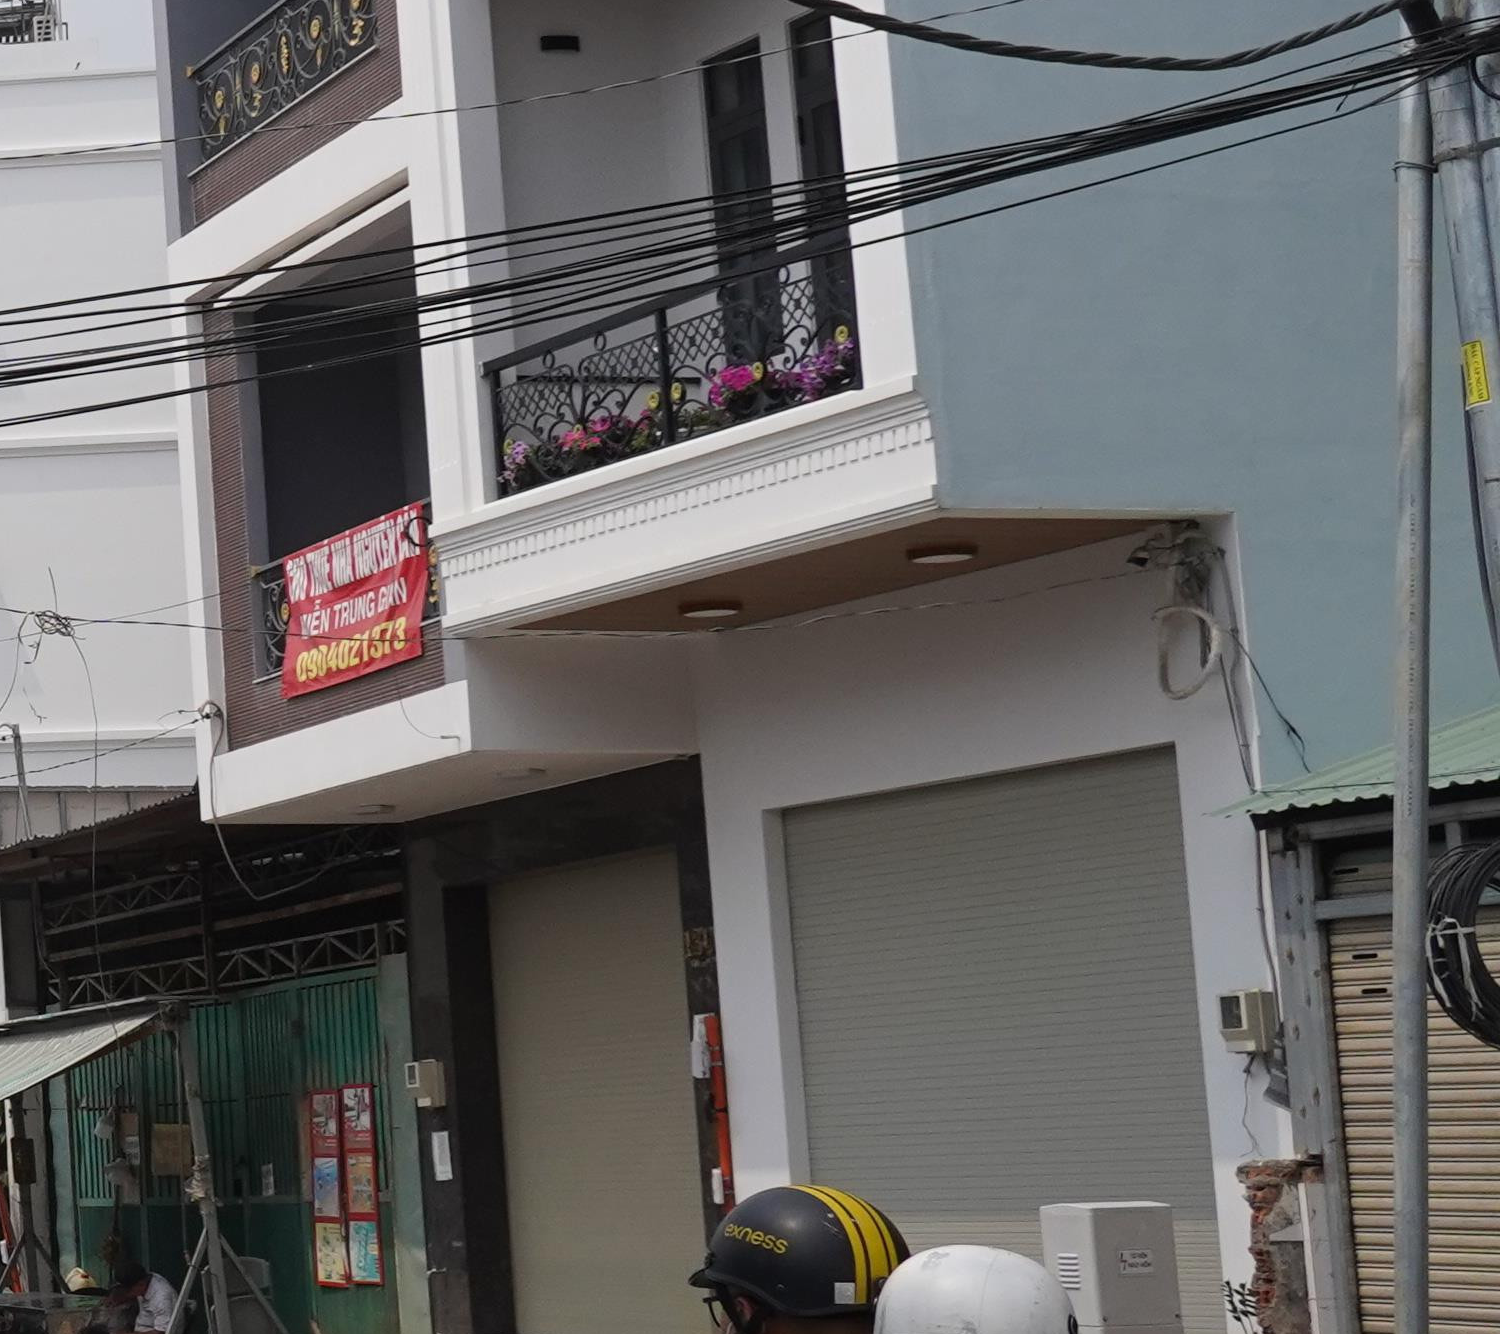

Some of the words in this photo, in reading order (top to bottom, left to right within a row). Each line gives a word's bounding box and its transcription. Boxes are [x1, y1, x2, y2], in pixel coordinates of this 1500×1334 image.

[333, 590, 376, 630] TRUNG
[296, 616, 407, 684] 0904021373
[724, 1223, 789, 1254] exness
